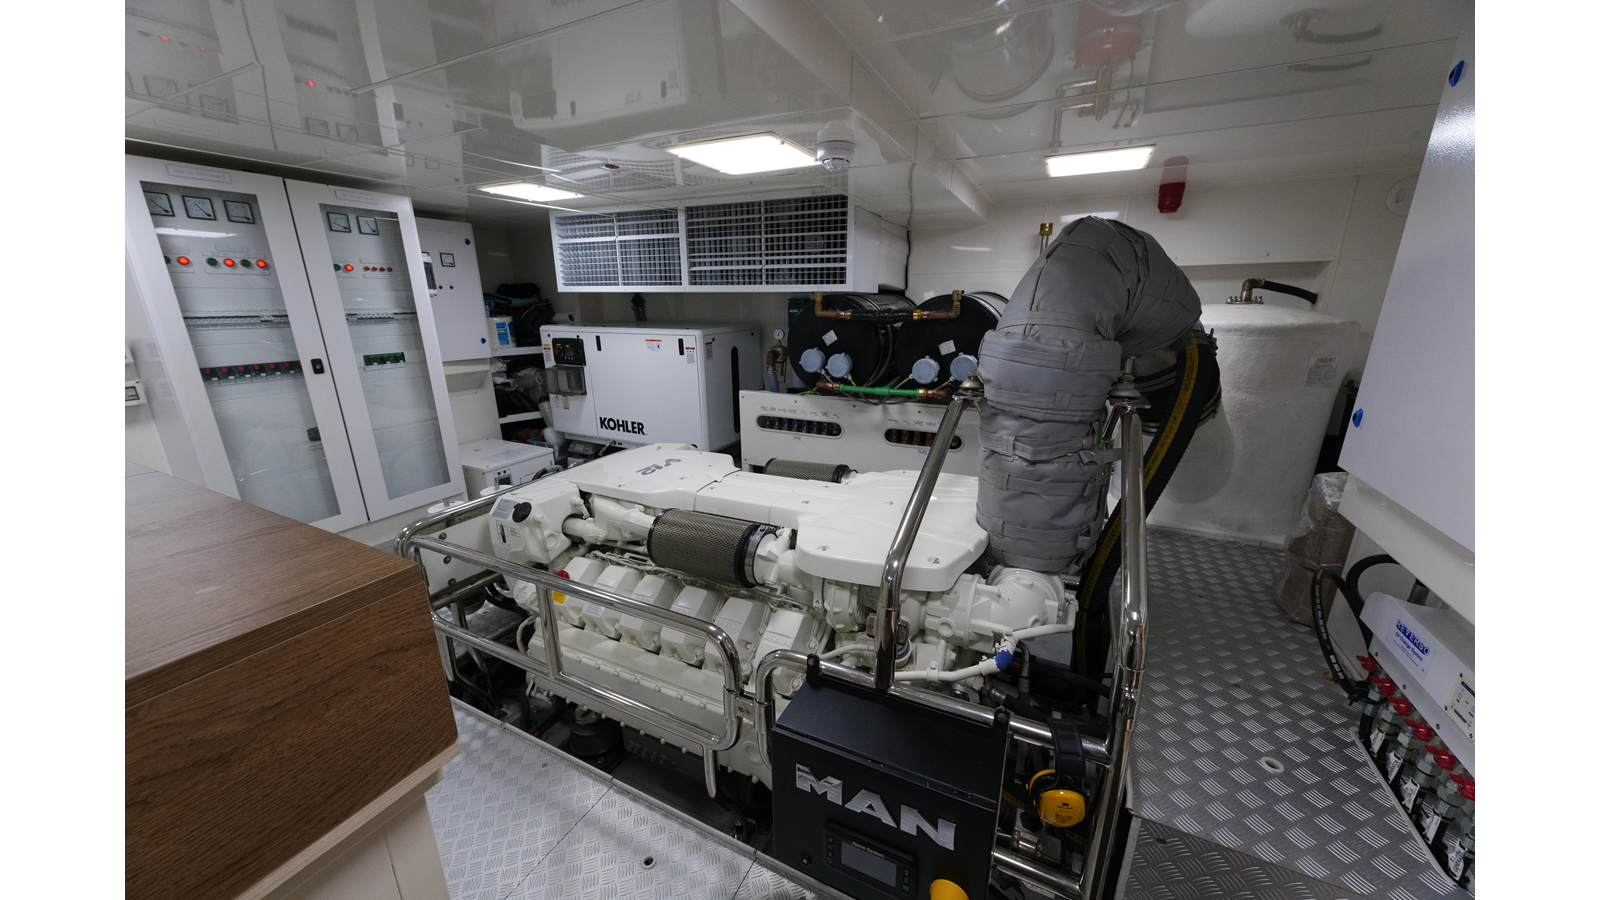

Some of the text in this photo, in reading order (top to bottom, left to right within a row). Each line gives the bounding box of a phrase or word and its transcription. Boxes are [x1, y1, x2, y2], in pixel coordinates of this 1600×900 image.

[599, 416, 646, 436] KOHLER
[636, 458, 682, 476] V12
[1395, 618, 1430, 656] REVERSO
[1400, 635, 1412, 650] Change
[1411, 647, 1423, 662] System
[795, 763, 957, 851] MAN
[867, 847, 885, 859] System
